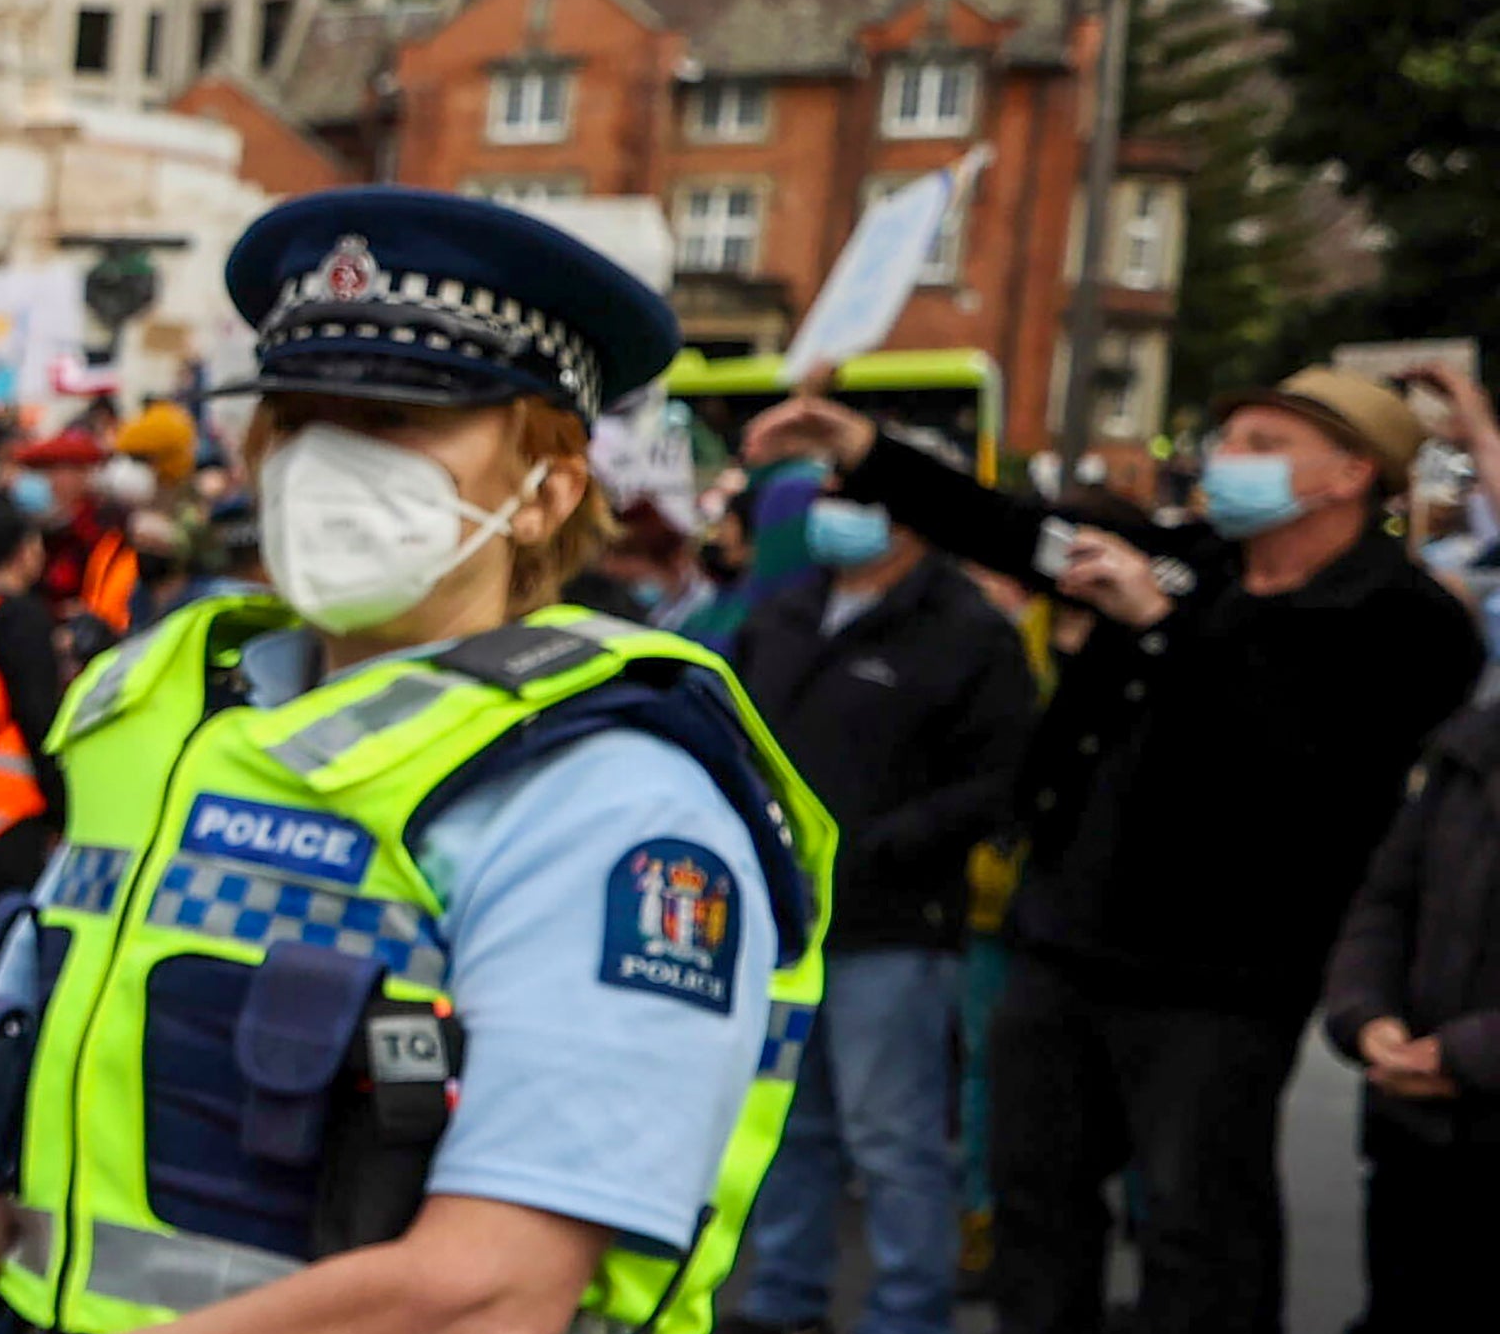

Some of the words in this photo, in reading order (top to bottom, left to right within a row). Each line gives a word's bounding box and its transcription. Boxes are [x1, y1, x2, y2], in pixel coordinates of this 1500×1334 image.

[193, 804, 357, 866] POLICE
[620, 954, 726, 1002] POLICE
[382, 1033, 438, 1062] TQ
